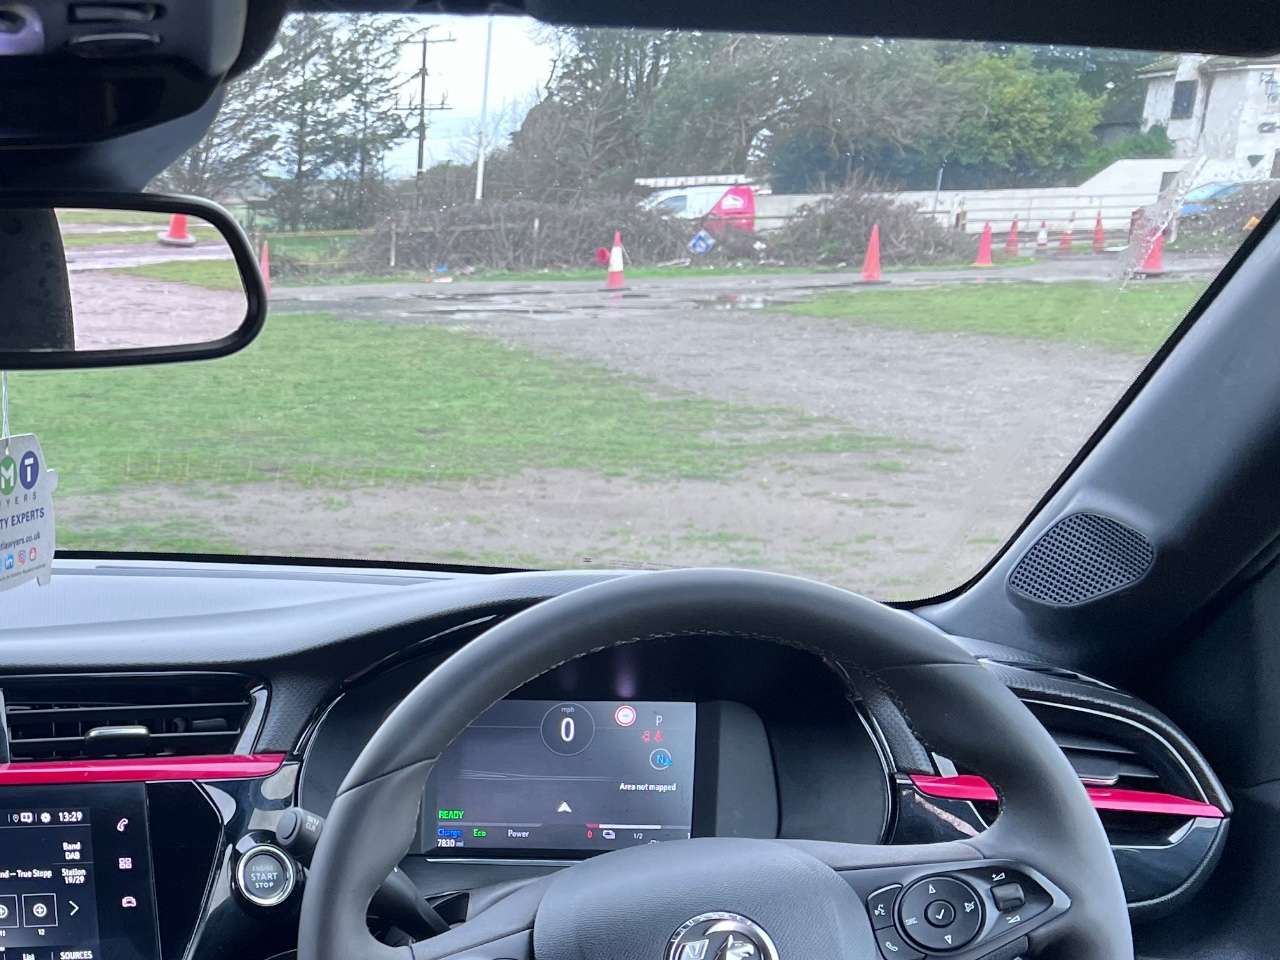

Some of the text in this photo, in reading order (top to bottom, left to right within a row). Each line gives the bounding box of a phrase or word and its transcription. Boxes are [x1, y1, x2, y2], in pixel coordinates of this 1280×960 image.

[11, 507, 45, 527] EXPERTS
[561, 707, 575, 715] mph
[656, 715, 663, 726] P
[561, 717, 575, 742] 0
[620, 783, 677, 793] Area not mapped
[58, 811, 83, 822] 13:29
[438, 810, 465, 819] READY
[473, 828, 487, 837] Eco
[507, 829, 529, 838] Power
[63, 842, 81, 851] Band
[437, 839, 455, 847] 7830
[65, 851, 81, 860] DAB
[17, 869, 32, 878] True
[62, 868, 87, 876] Station
[250, 873, 278, 881] START
[60, 951, 93, 960] SOURCES
